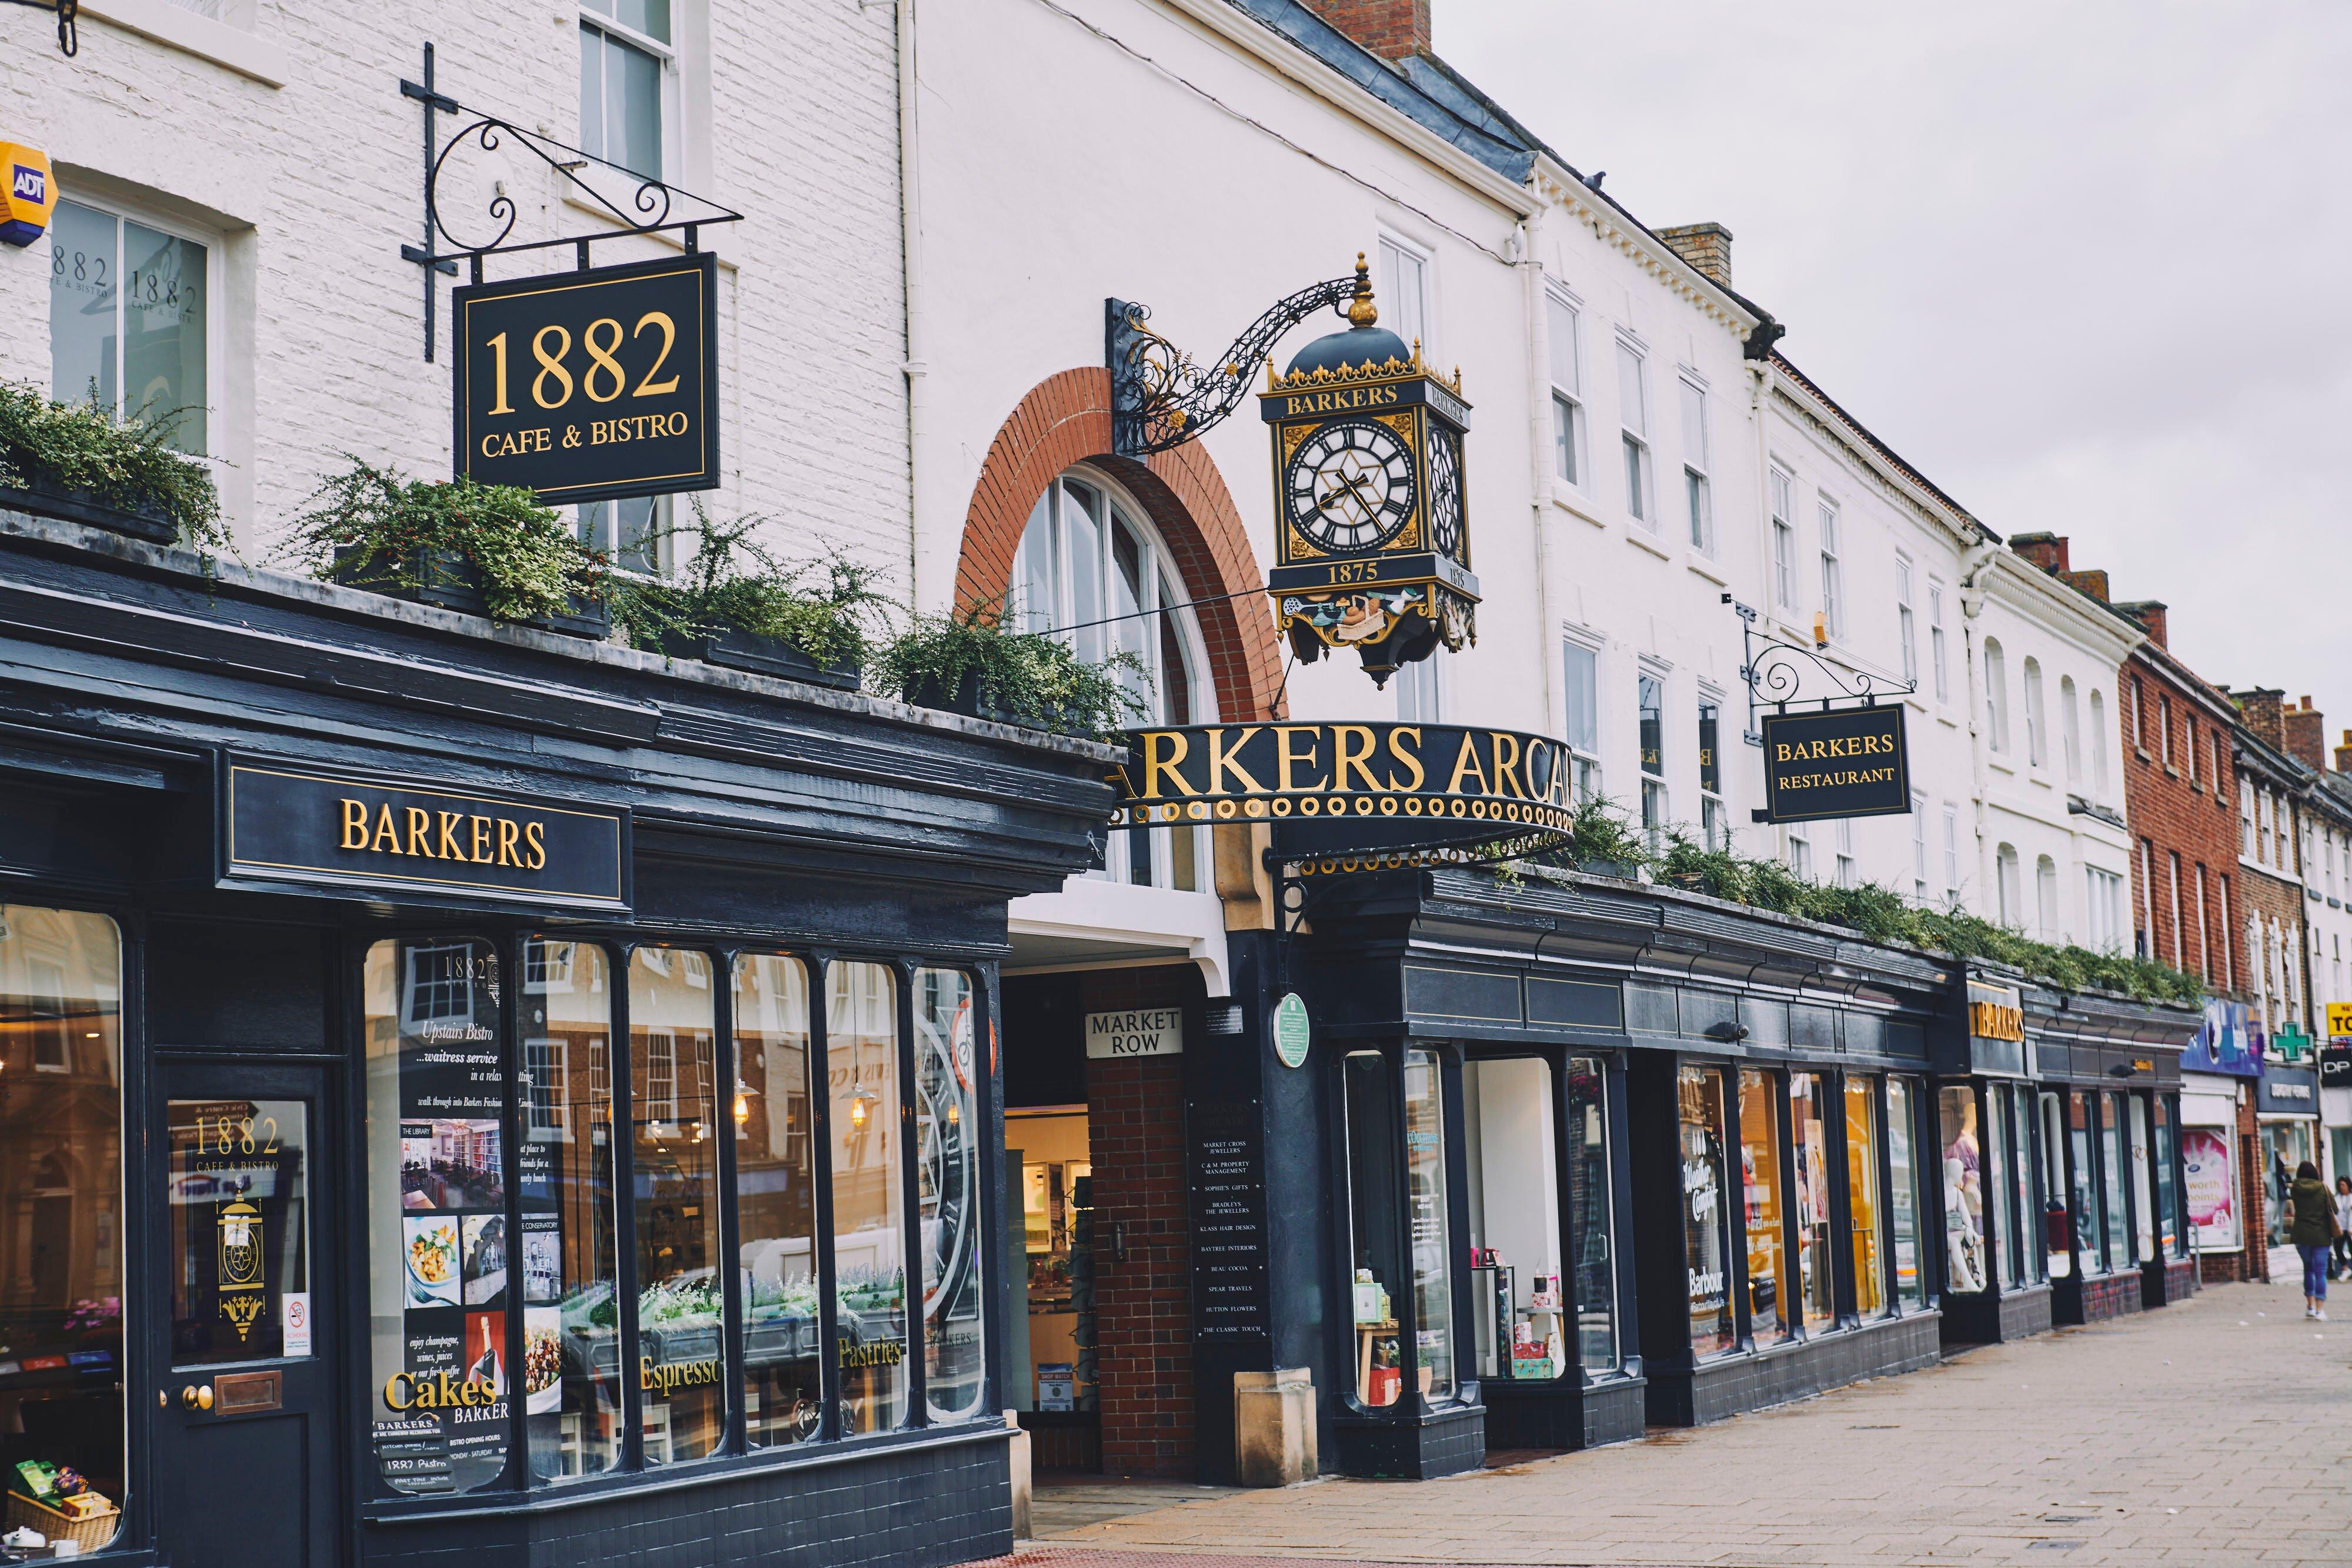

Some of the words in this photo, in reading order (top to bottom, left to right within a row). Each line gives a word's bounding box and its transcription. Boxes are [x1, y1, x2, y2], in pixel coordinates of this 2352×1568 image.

[14, 172, 44, 198] ADT
[76, 282, 107, 298] BISTRO
[133, 270, 197, 315] 1882
[132, 300, 154, 313] CAFE
[486, 311, 680, 415] 1882
[1287, 385, 1398, 415] BARKERS
[482, 427, 552, 457] CAFE
[562, 424, 582, 449] &
[590, 412, 688, 446] BISTRO
[1328, 561, 1378, 584] 1875
[1449, 567, 1465, 588] 1875
[1776, 734, 1895, 762] BARKERS
[1779, 767, 1895, 790] RESTAURANT
[339, 798, 547, 870] BARKERS
[446, 957, 485, 979] 1882
[422, 1021, 463, 1044] Upstairs
[466, 1022, 493, 1040] Bistro
[1092, 1011, 1179, 1034] MARKET
[1982, 1001, 2024, 1043] BARKERS
[1112, 1033, 1160, 1054] ROW
[466, 1051, 498, 1064] service
[2324, 1061, 2350, 1074] DP
[471, 1068, 477, 1081] in
[418, 1096, 431, 1106] walk
[433, 1096, 452, 1109] through
[453, 1096, 462, 1106] into
[463, 1096, 482, 1106] Barkers
[196, 1117, 279, 1155] 1882
[526, 1144, 539, 1156] place
[540, 1145, 546, 1153] to
[196, 1162, 224, 1172] CAFE
[229, 1162, 236, 1171] &
[241, 1161, 279, 1171] BISTRO
[536, 1159, 544, 1170] for
[533, 1173, 546, 1183] lunch
[2189, 1179, 2220, 1189] worth
[1689, 1266, 1724, 1296] Barbour
[410, 1336, 425, 1350] enjoy
[425, 1335, 459, 1348] champagne,
[838, 1334, 901, 1369] Pastries
[417, 1352, 435, 1363] wines,
[435, 1350, 453, 1363] juices
[418, 1370, 428, 1378] our
[444, 1365, 460, 1378] coffee
[640, 1356, 721, 1397] Espresso
[385, 1372, 497, 1409] Cakes
[377, 1419, 433, 1430] BARKERS
[449, 1438, 465, 1446] BISTRO
[485, 1434, 502, 1442] HOURS:
[418, 1459, 446, 1468] Bistro
[471, 1449, 493, 1457] SATURDAY
